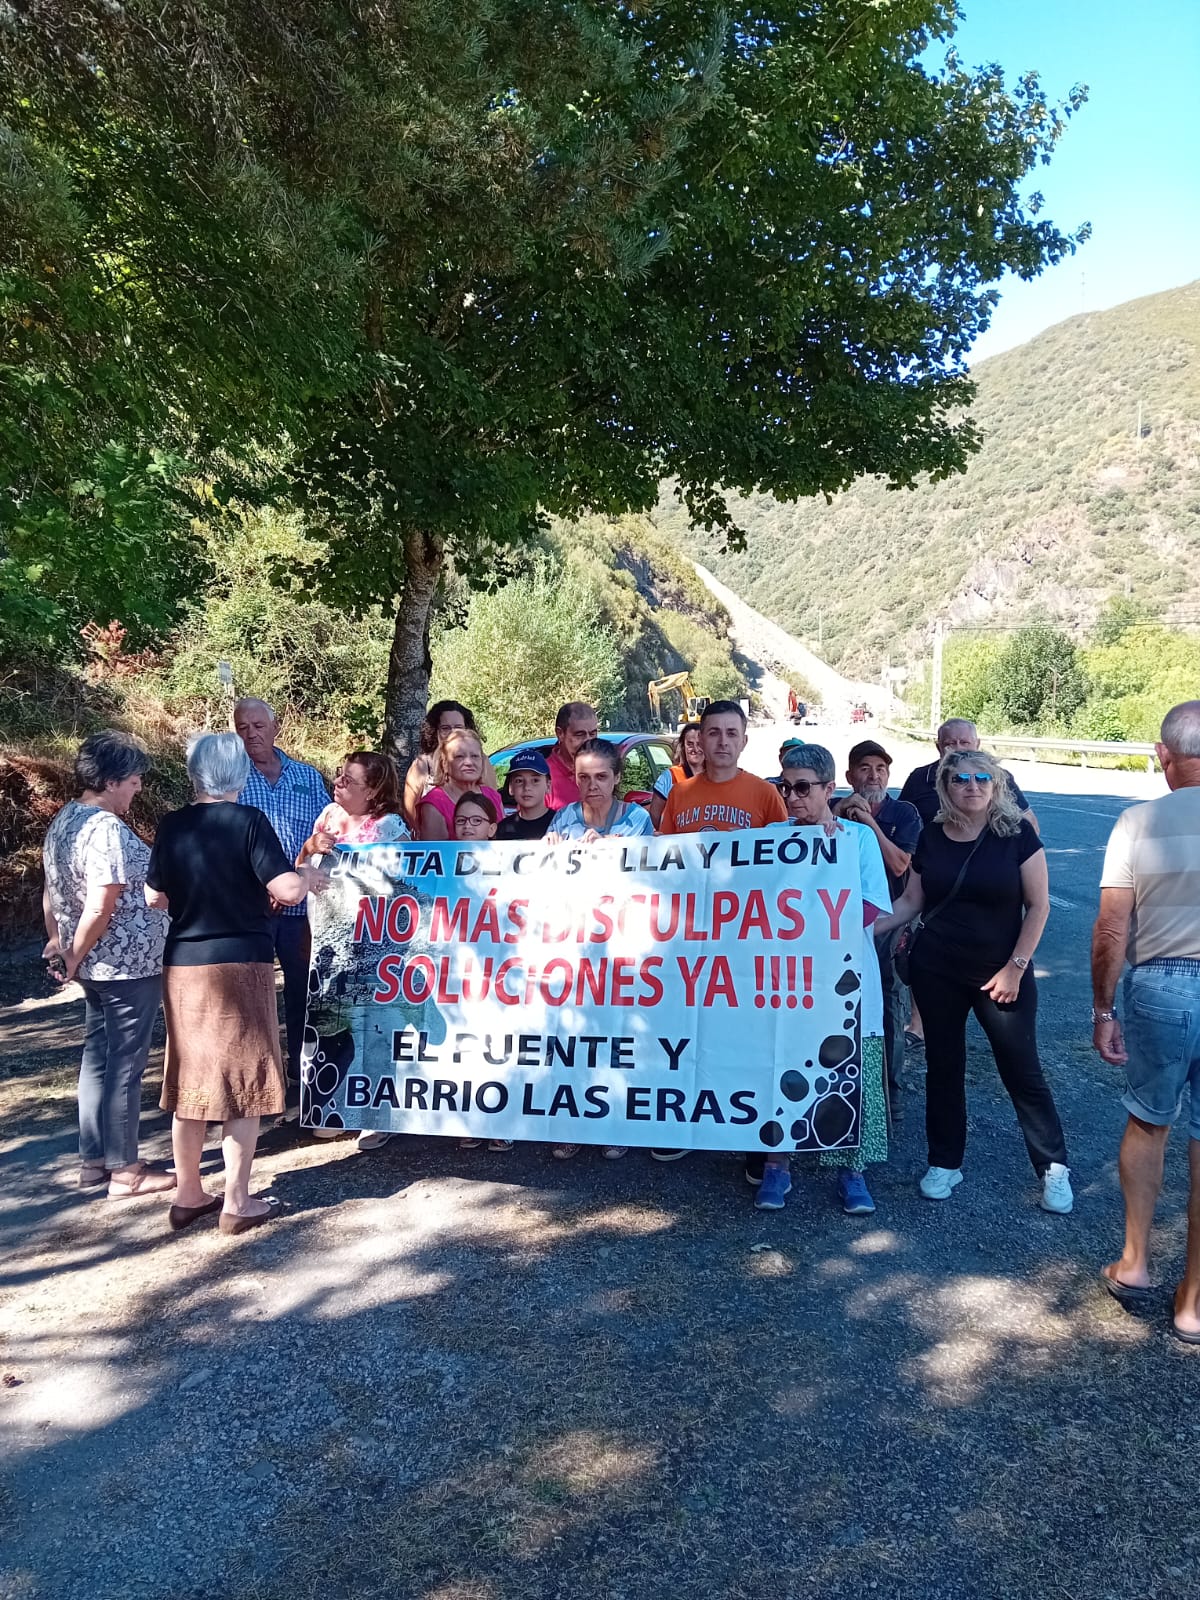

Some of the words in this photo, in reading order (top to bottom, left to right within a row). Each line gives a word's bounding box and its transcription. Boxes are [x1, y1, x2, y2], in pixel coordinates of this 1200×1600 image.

[676, 806, 701, 828] PALM
[703, 804, 752, 829] SPRINGS
[331, 850, 444, 878] JUNTA
[455, 850, 502, 877] D
[512, 843, 686, 875] CASLLA
[696, 842, 720, 869] Y
[730, 831, 838, 867] LEÓN
[353, 894, 421, 944] NO
[429, 887, 529, 944] MÁS
[816, 888, 851, 941] Y
[373, 955, 665, 1007] SOLUCIONES
[676, 955, 739, 1008] YA
[753, 955, 815, 1010] !!!!
[392, 1030, 439, 1063] EL
[452, 1032, 636, 1069] PUENTE
[658, 1037, 691, 1071] Y
[345, 1075, 509, 1114] BARRIO
[522, 1082, 611, 1120] LAS
[625, 1086, 759, 1125] ERAS
